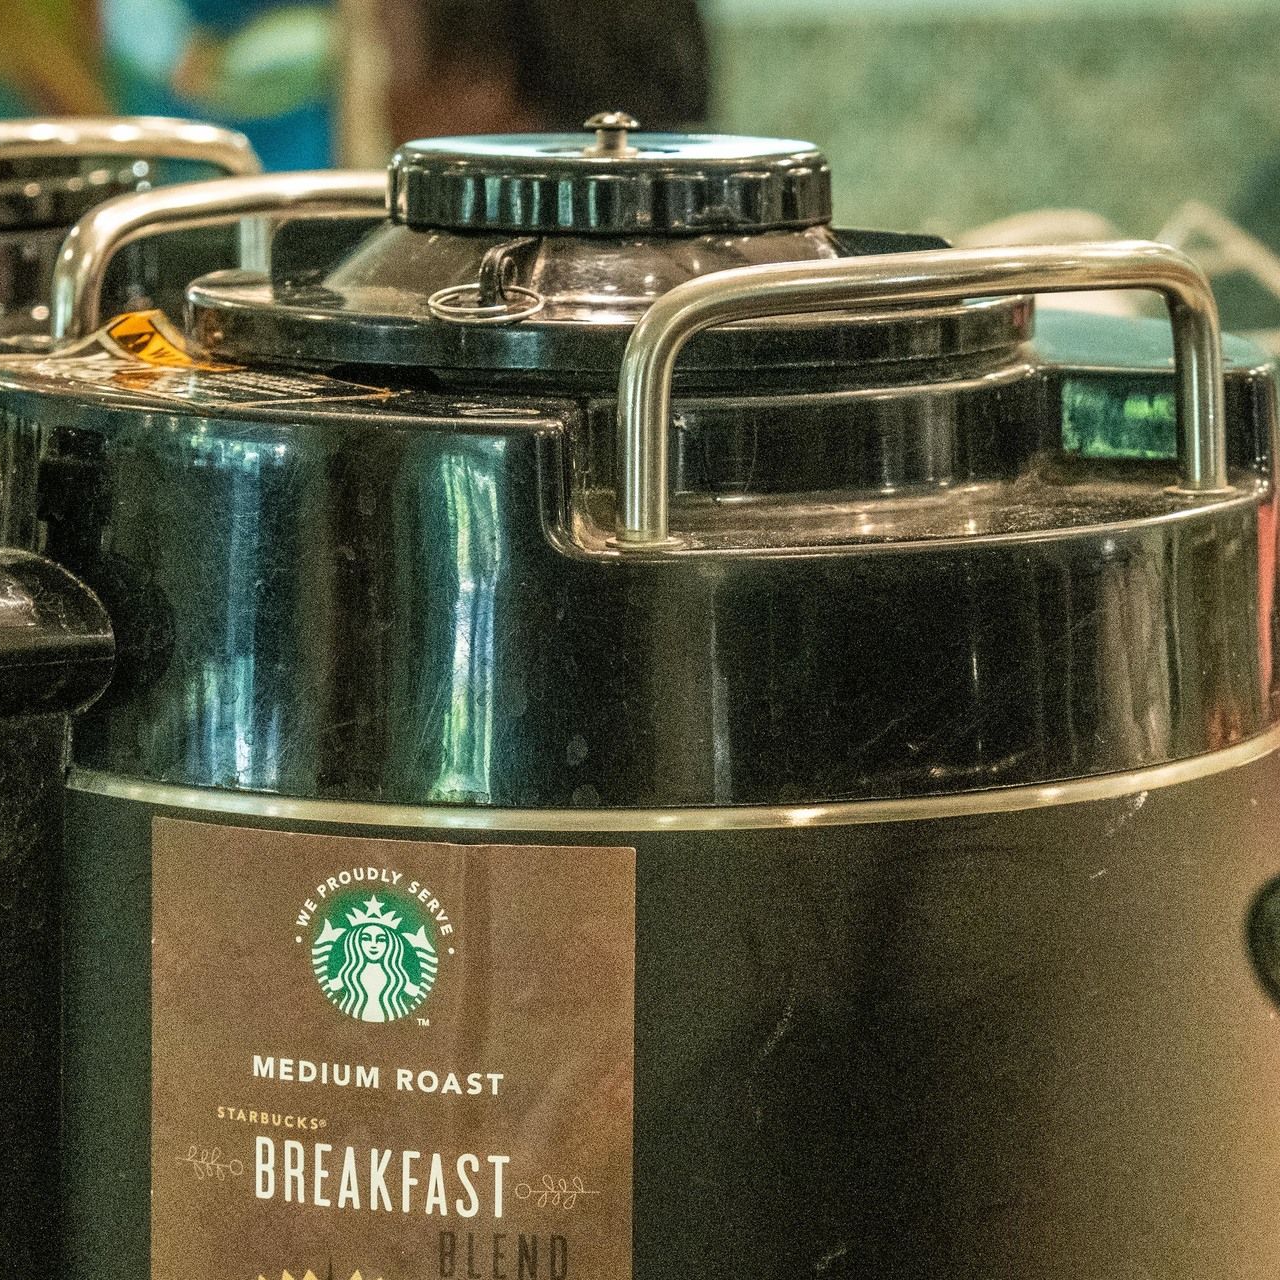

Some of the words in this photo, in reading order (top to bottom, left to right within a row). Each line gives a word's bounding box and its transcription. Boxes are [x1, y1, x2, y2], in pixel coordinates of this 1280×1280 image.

[296, 899, 317, 927] WE
[316, 867, 403, 898] PROUDLY
[407, 881, 454, 936] SERVE
[252, 1055, 380, 1089] MEDIUM
[397, 1068, 504, 1096] ROAST
[255, 1136, 510, 1219] BREAKFAST
